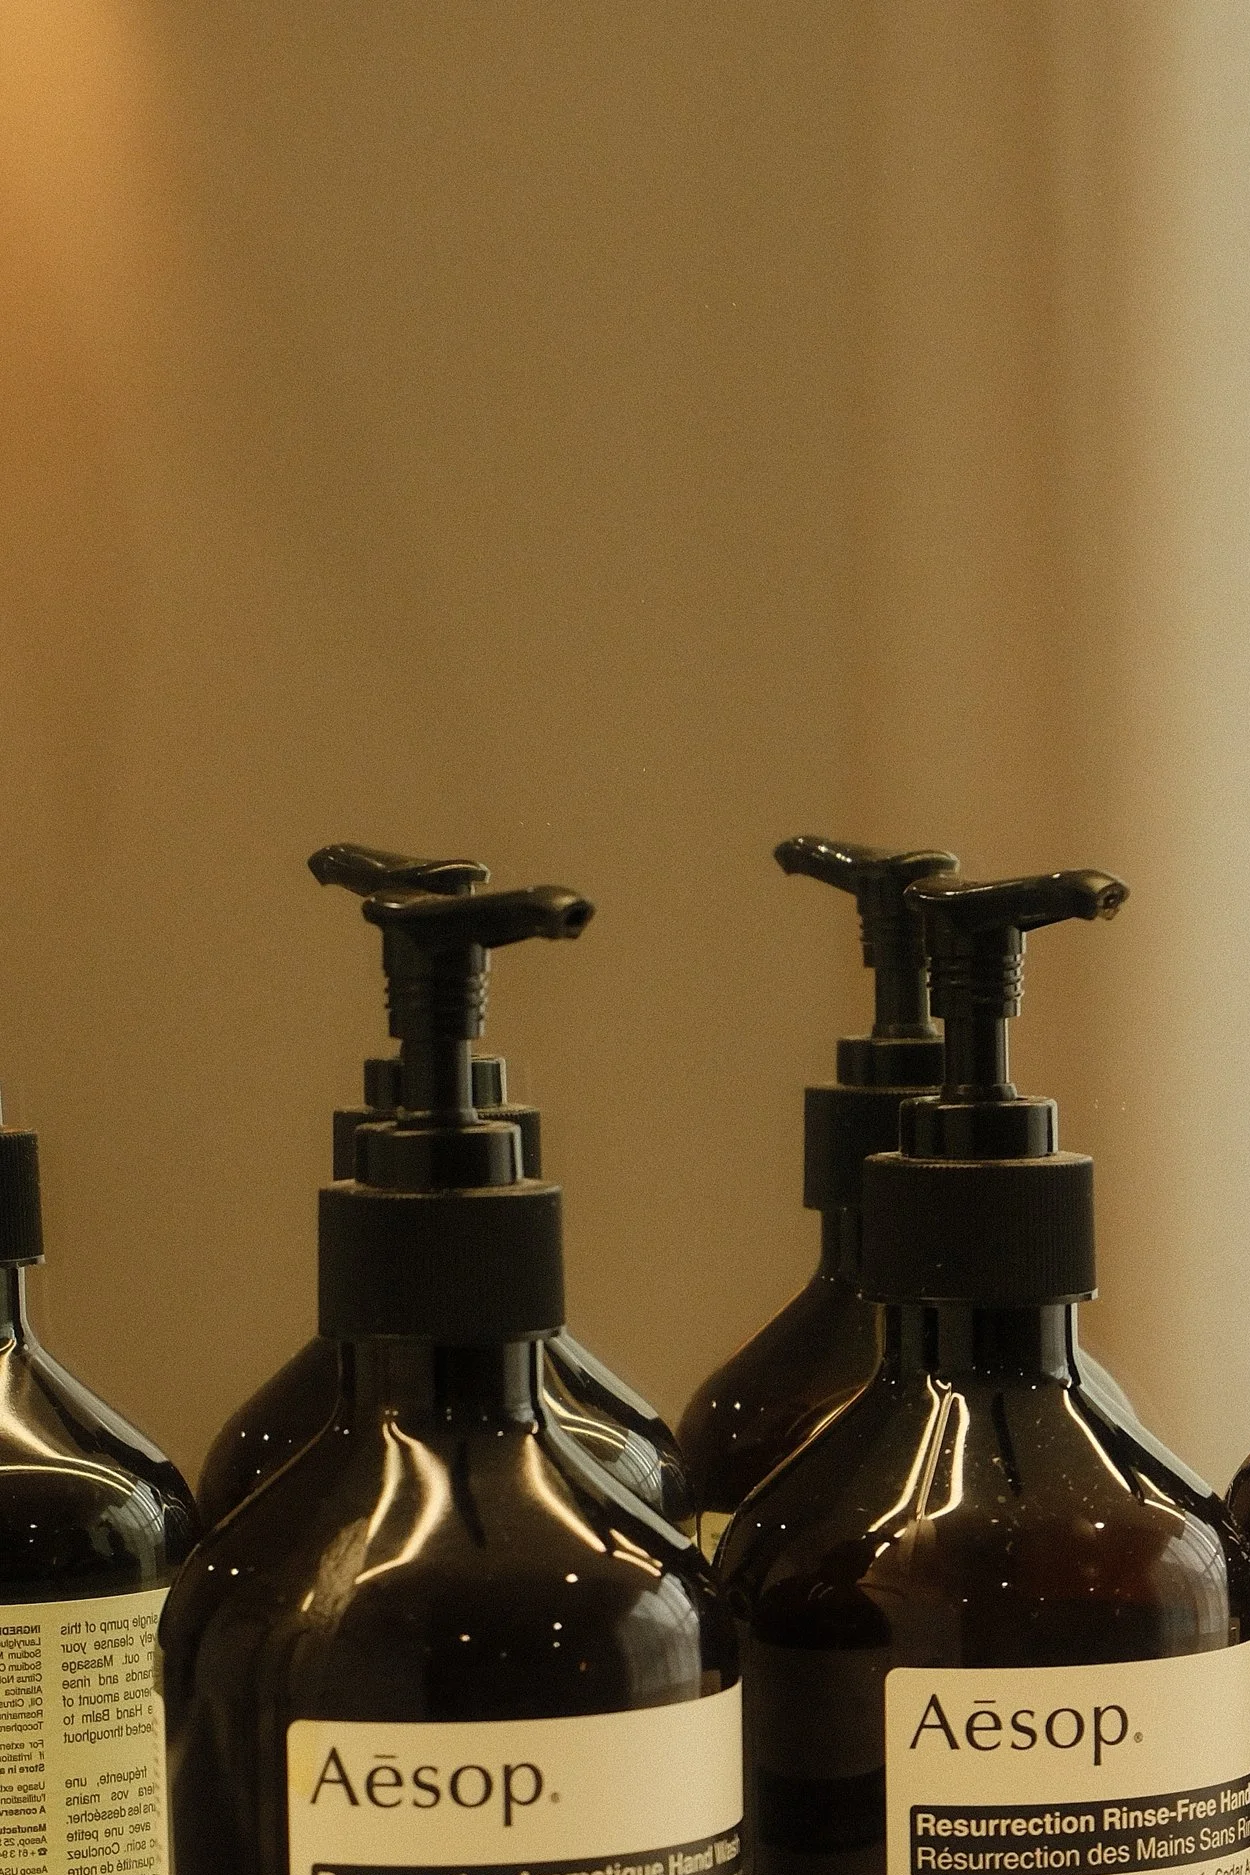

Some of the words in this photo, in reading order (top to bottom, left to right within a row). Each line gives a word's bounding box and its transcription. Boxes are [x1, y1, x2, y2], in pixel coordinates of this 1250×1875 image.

[916, 1813, 1095, 1837] Resurrection
[1103, 1798, 1217, 1832] Rinse-Free
[1221, 1786, 1250, 1813] Hand
[917, 1842, 1079, 1870] Résurrection
[1087, 1841, 1130, 1865] des
[1136, 1833, 1196, 1861] Mains
[1200, 1822, 1236, 1850] Sans
